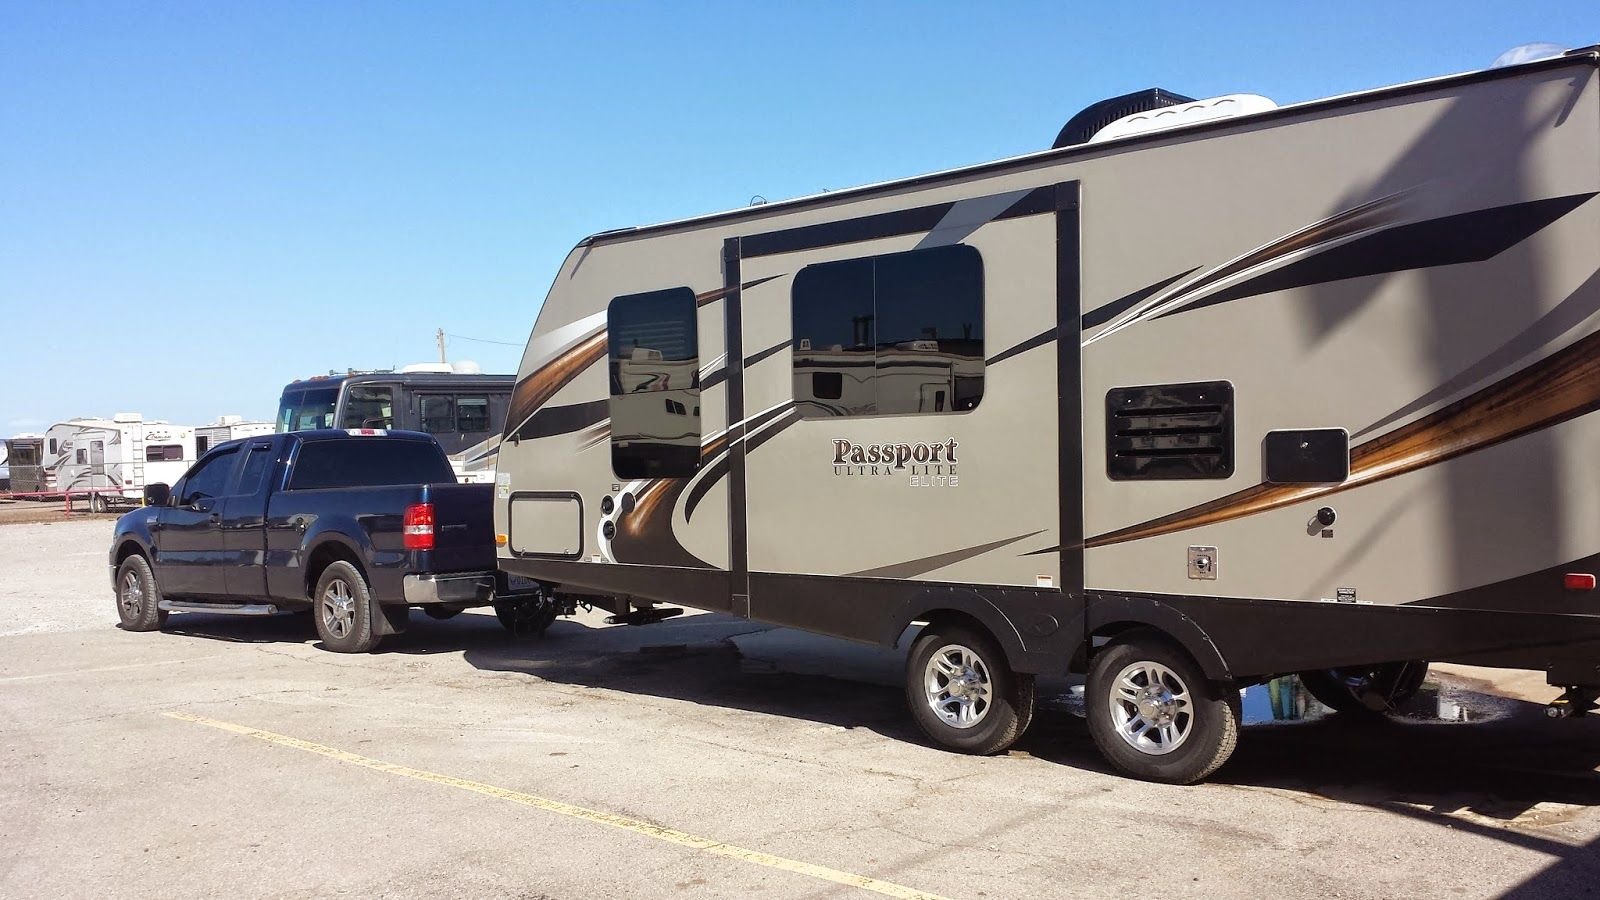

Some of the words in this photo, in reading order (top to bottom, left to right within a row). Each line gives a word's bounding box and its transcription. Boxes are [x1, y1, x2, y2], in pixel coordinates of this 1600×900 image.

[831, 438, 959, 471] Passport
[834, 465, 892, 476] ULTRA
[911, 464, 958, 475] LITE
[909, 475, 959, 487] ELITE
